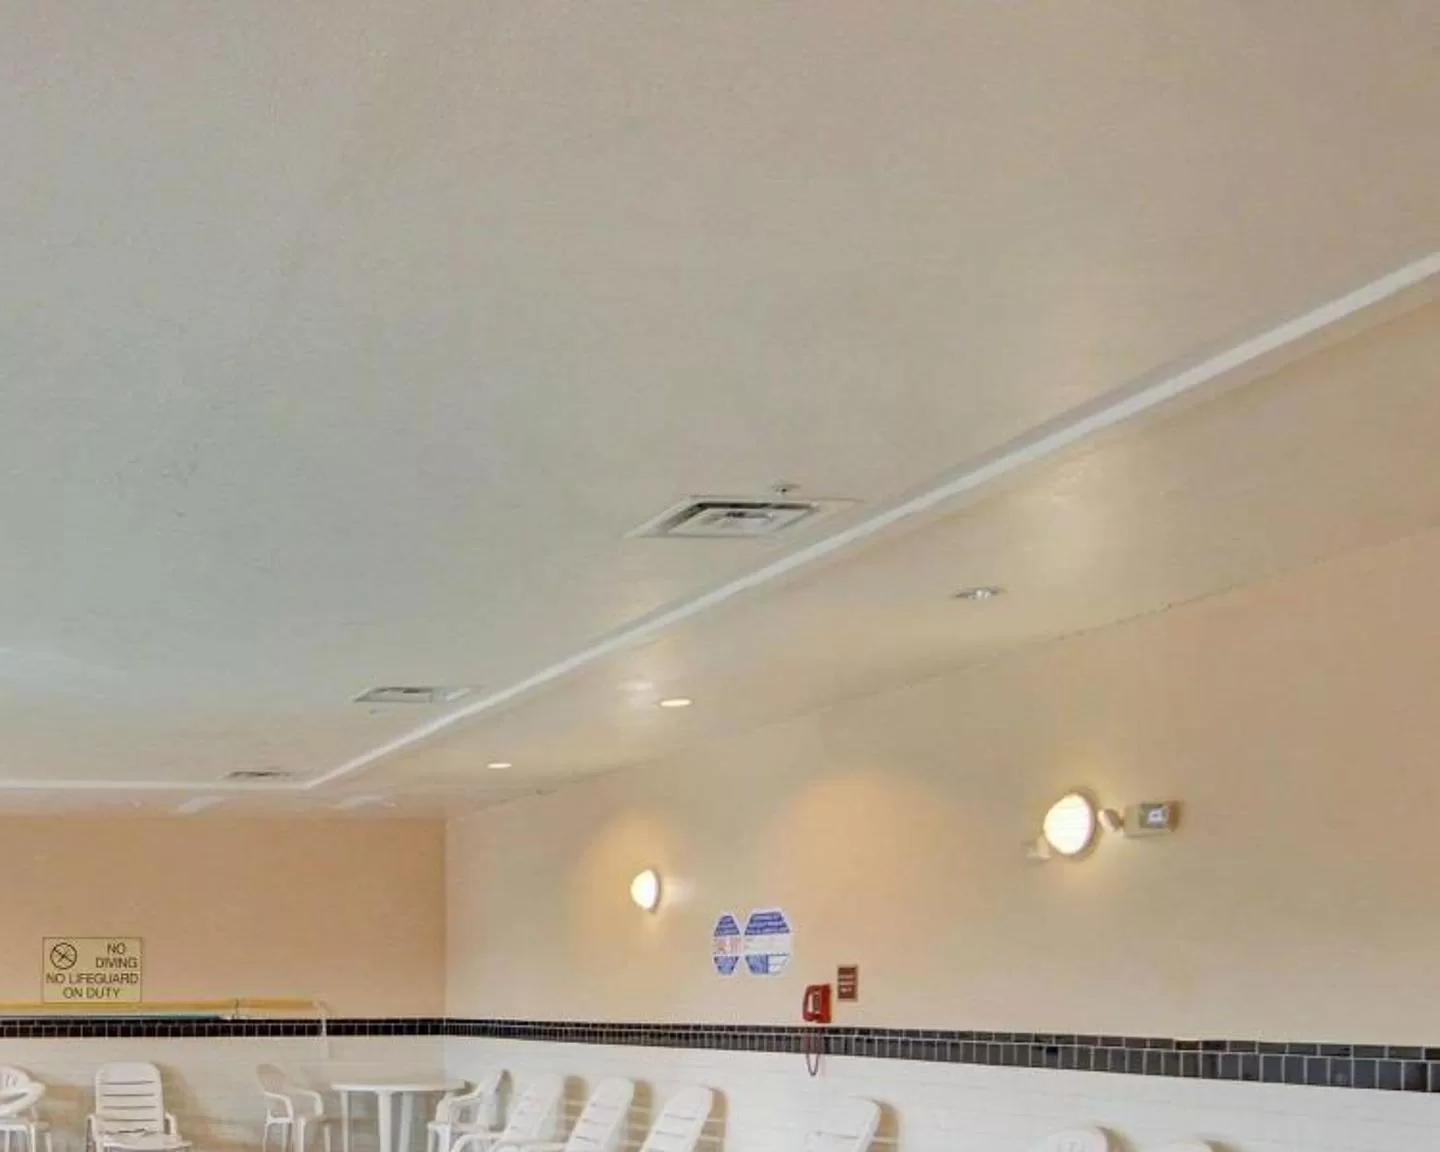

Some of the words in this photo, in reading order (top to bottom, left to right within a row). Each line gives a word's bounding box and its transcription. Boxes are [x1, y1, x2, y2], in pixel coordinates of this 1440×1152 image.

[106, 942, 126, 955] NO
[95, 956, 138, 969] DIVING
[45, 972, 66, 985] NO
[68, 972, 140, 985] LIFEGUARD
[62, 986, 83, 999] ON
[85, 986, 121, 999] DUTY
